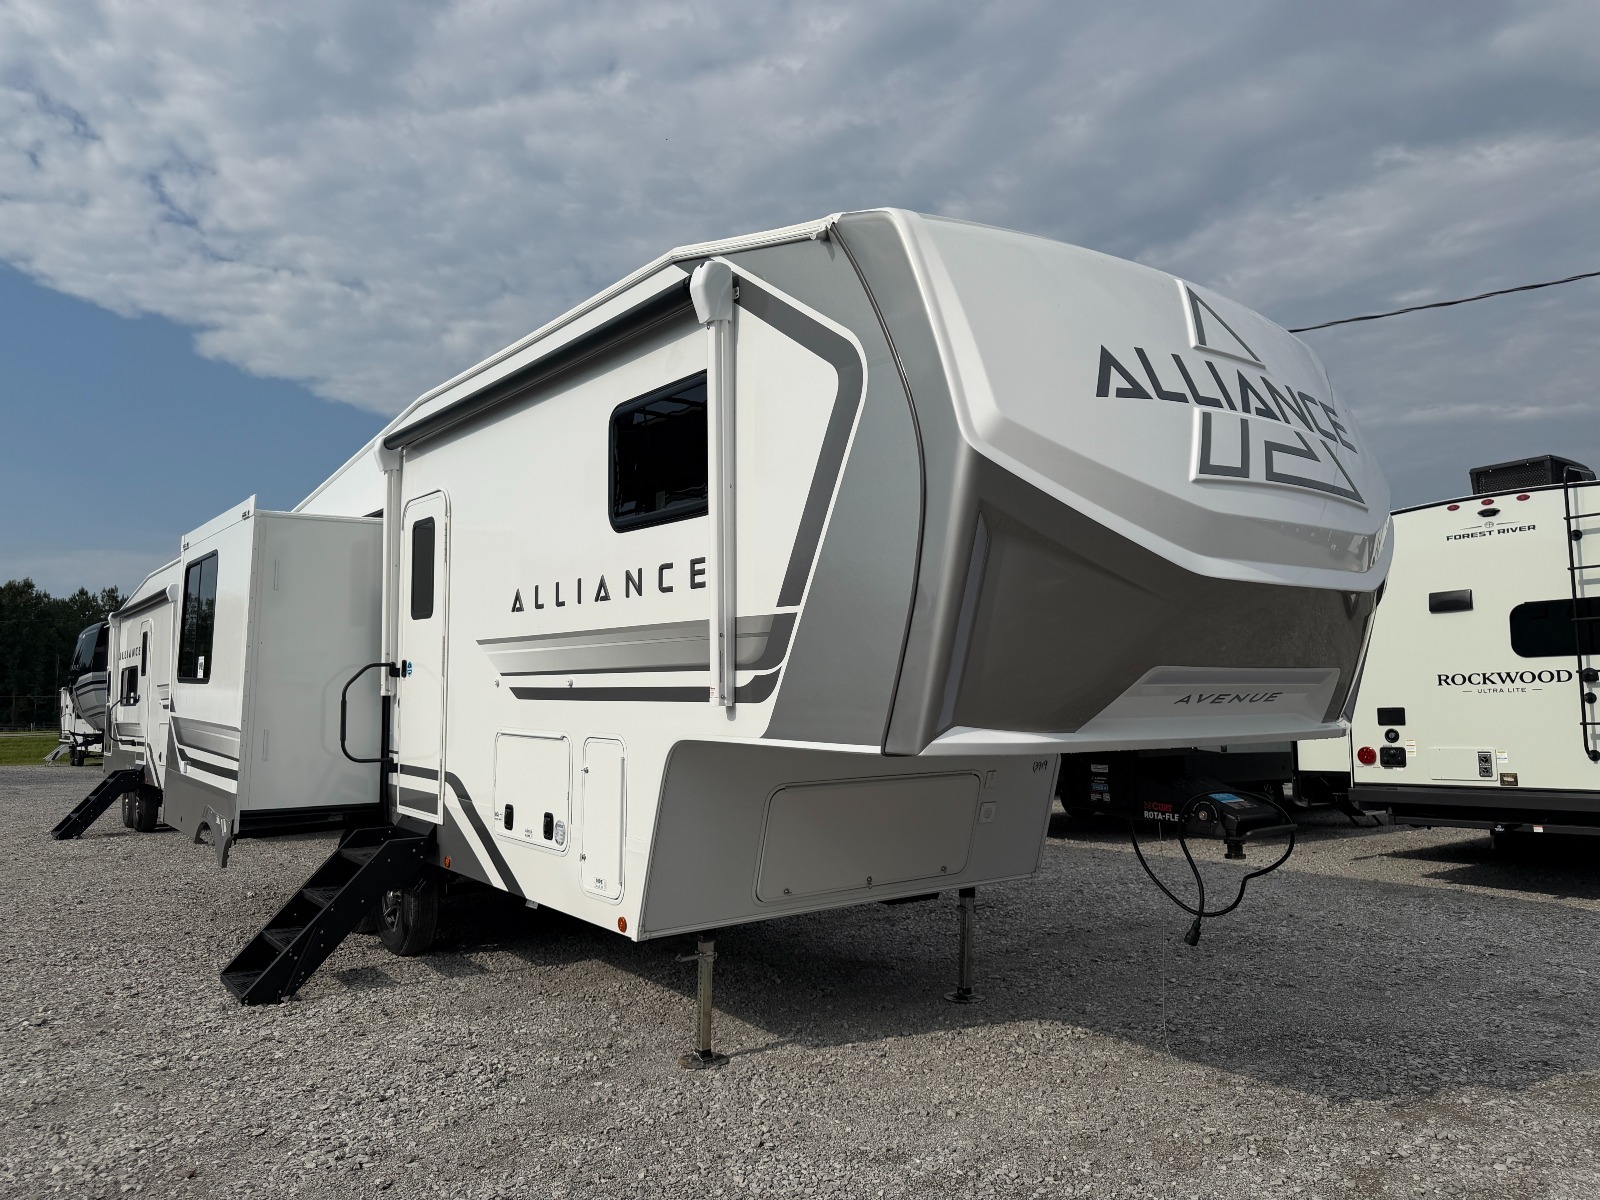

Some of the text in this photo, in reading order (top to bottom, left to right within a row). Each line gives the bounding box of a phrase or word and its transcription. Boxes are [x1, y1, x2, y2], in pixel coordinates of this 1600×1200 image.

[1095, 344, 1358, 454] ALLIANCE
[1445, 529, 1495, 542] FOREST
[1497, 524, 1536, 535] RIVER
[511, 556, 706, 613] ALLIANCE
[1437, 669, 1573, 687] ROCKWOOD
[1173, 691, 1284, 705] AVENUE
[1152, 802, 1173, 812] CURT
